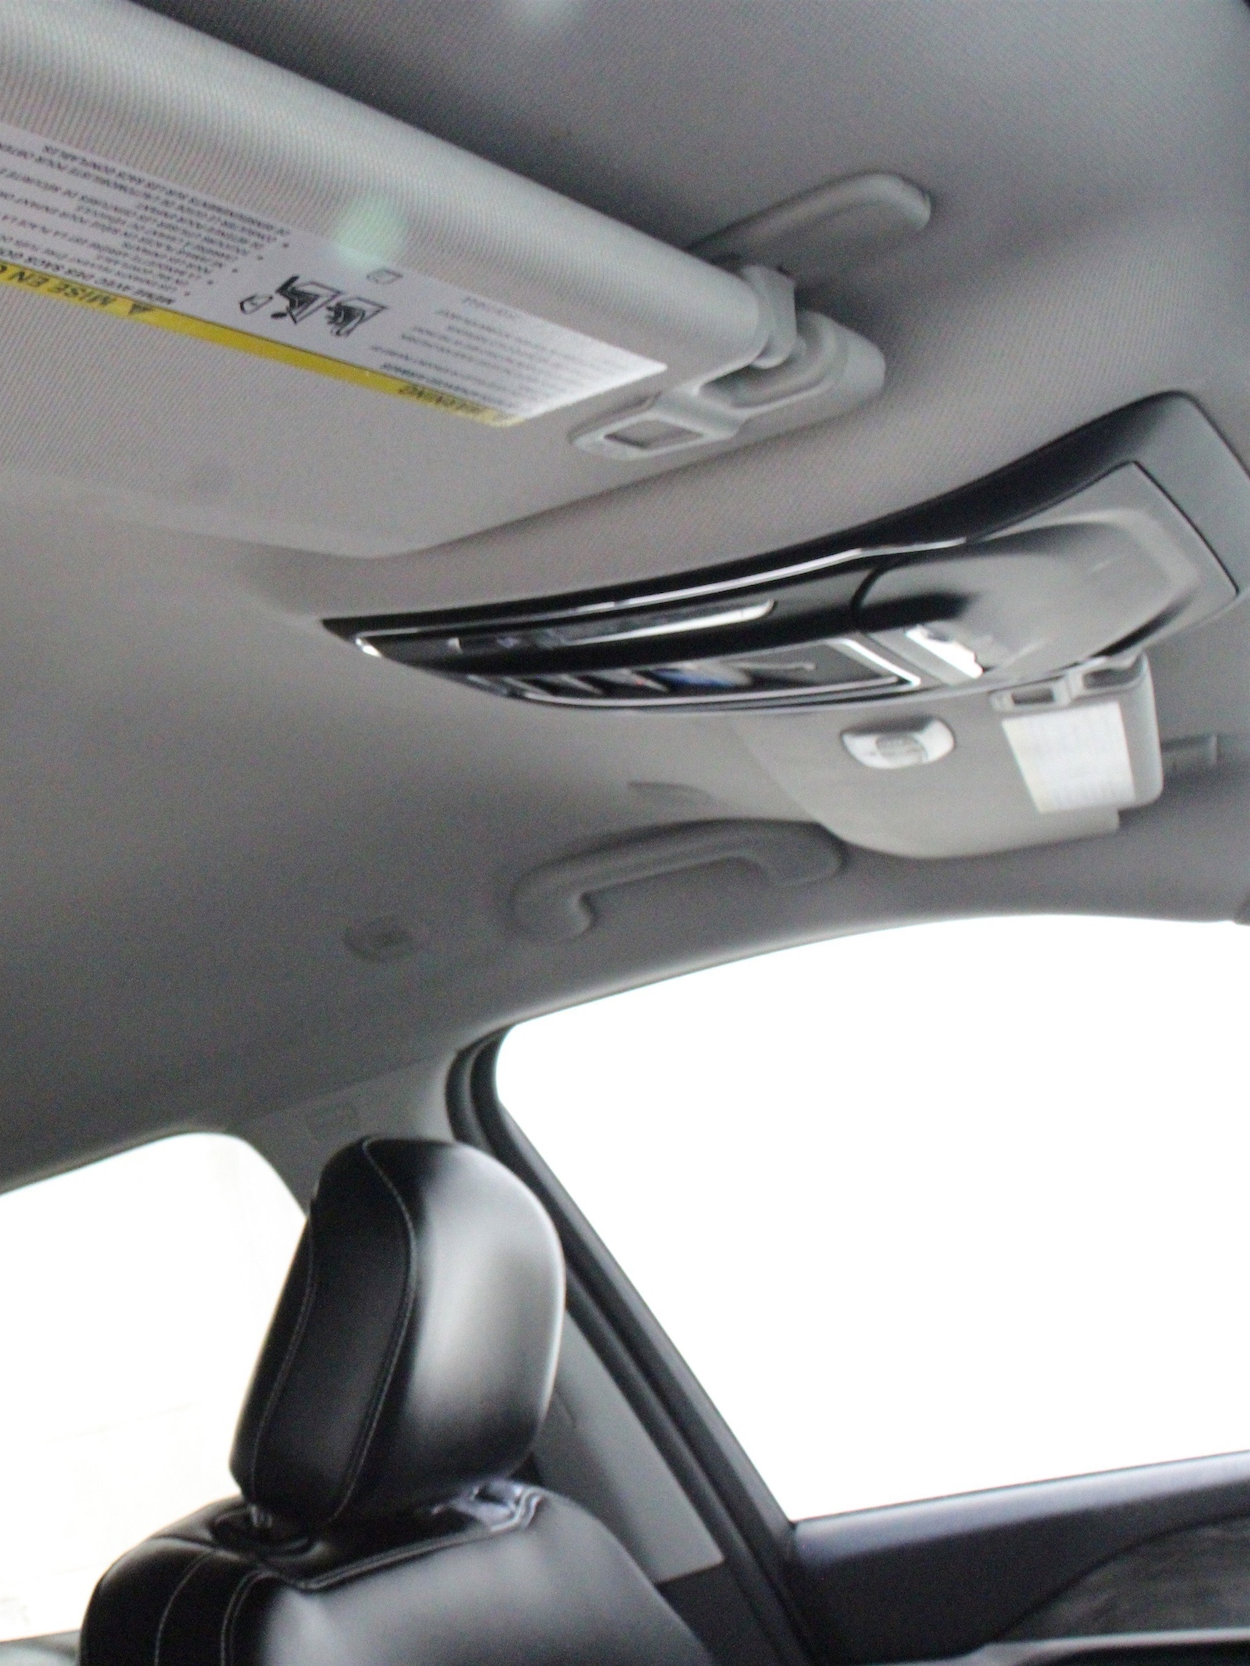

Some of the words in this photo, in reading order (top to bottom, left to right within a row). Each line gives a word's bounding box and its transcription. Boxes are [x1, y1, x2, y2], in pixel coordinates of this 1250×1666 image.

[3, 269, 52, 289] EN
[60, 267, 97, 281] DES
[92, 277, 135, 292] AVEC
[43, 281, 119, 308] MISE
